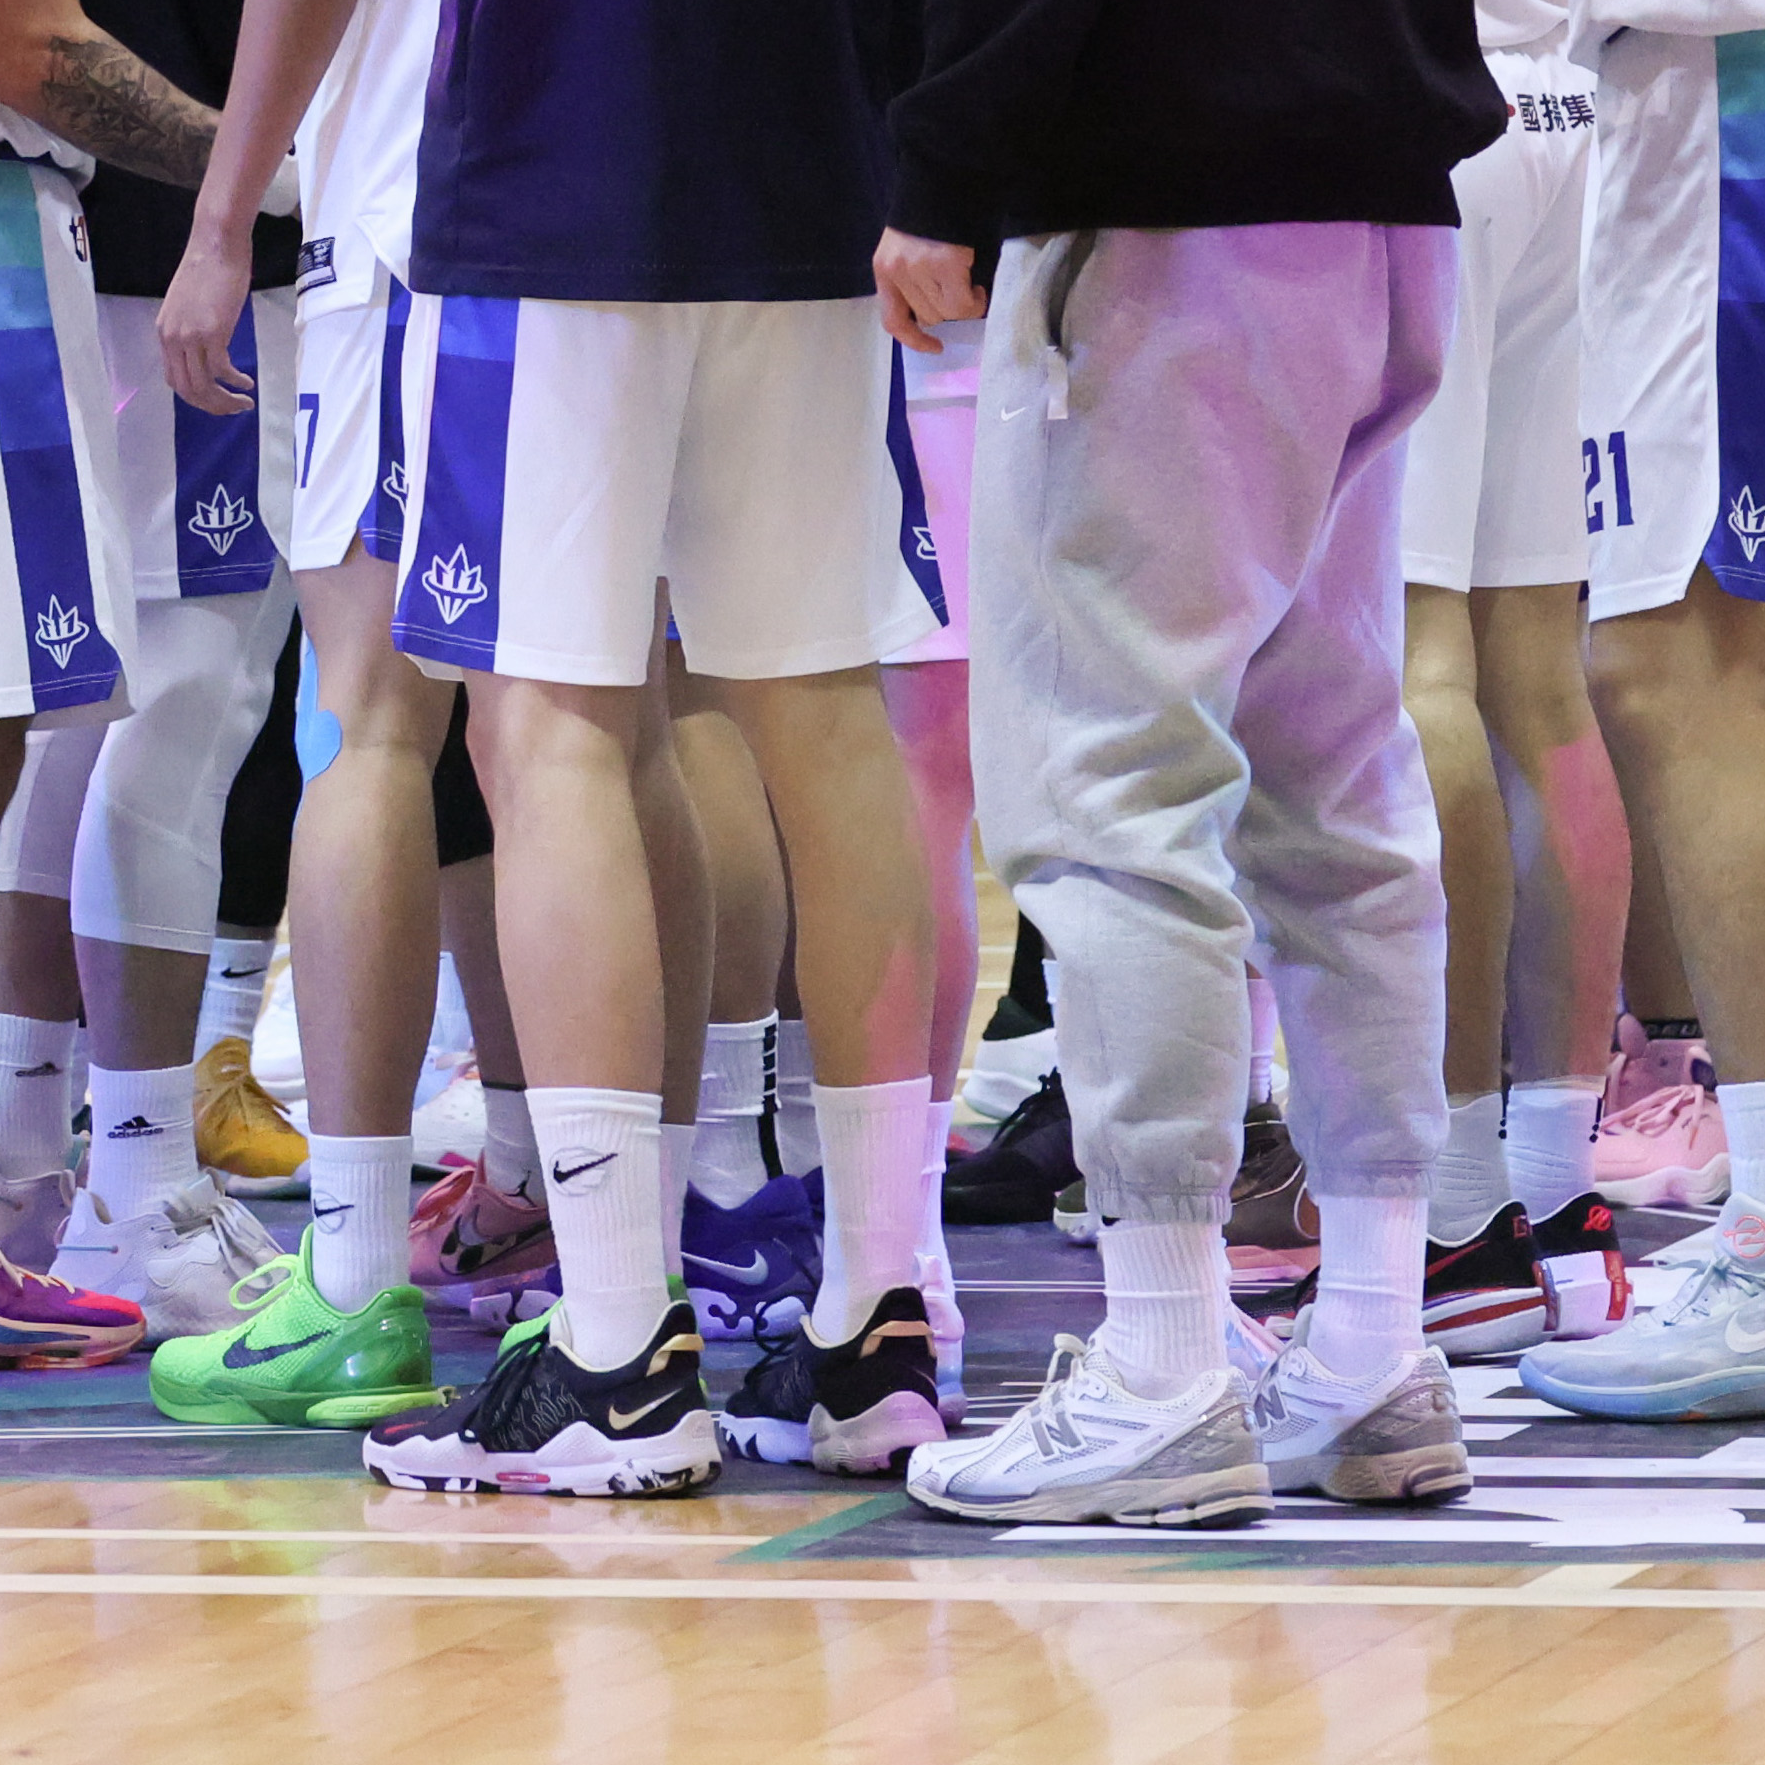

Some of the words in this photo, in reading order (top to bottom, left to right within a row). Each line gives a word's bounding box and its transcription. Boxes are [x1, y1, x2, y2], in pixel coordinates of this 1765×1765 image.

[1517, 92, 1597, 133] 國揚集
[294, 393, 319, 489] 7
[1582, 431, 1634, 534] 21
